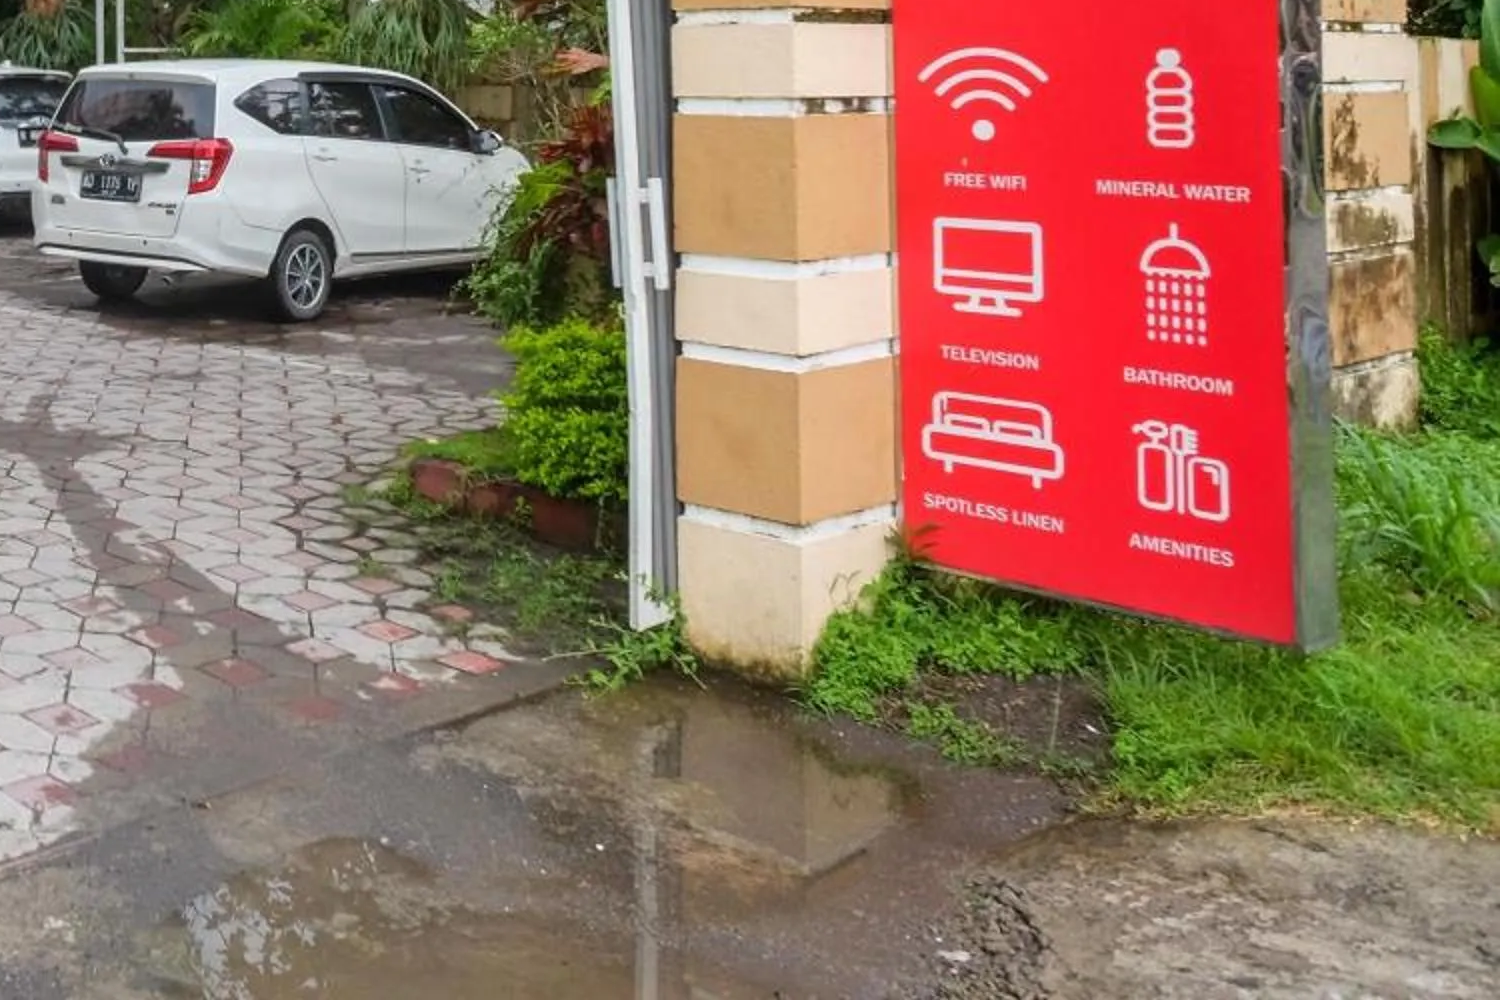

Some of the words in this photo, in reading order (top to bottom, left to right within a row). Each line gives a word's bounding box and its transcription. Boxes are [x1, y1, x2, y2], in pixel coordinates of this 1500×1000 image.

[943, 171, 986, 189] FREE
[989, 174, 1028, 192] WIFI
[1095, 178, 1179, 199] MINERAL
[1184, 183, 1251, 203] WATER
[939, 344, 1040, 370] TELEVISION
[1123, 366, 1235, 395] BATHROOM
[922, 492, 1009, 523] SPOTLESS
[1011, 510, 1065, 534] LINEN
[1129, 532, 1235, 567] AMENITIES
